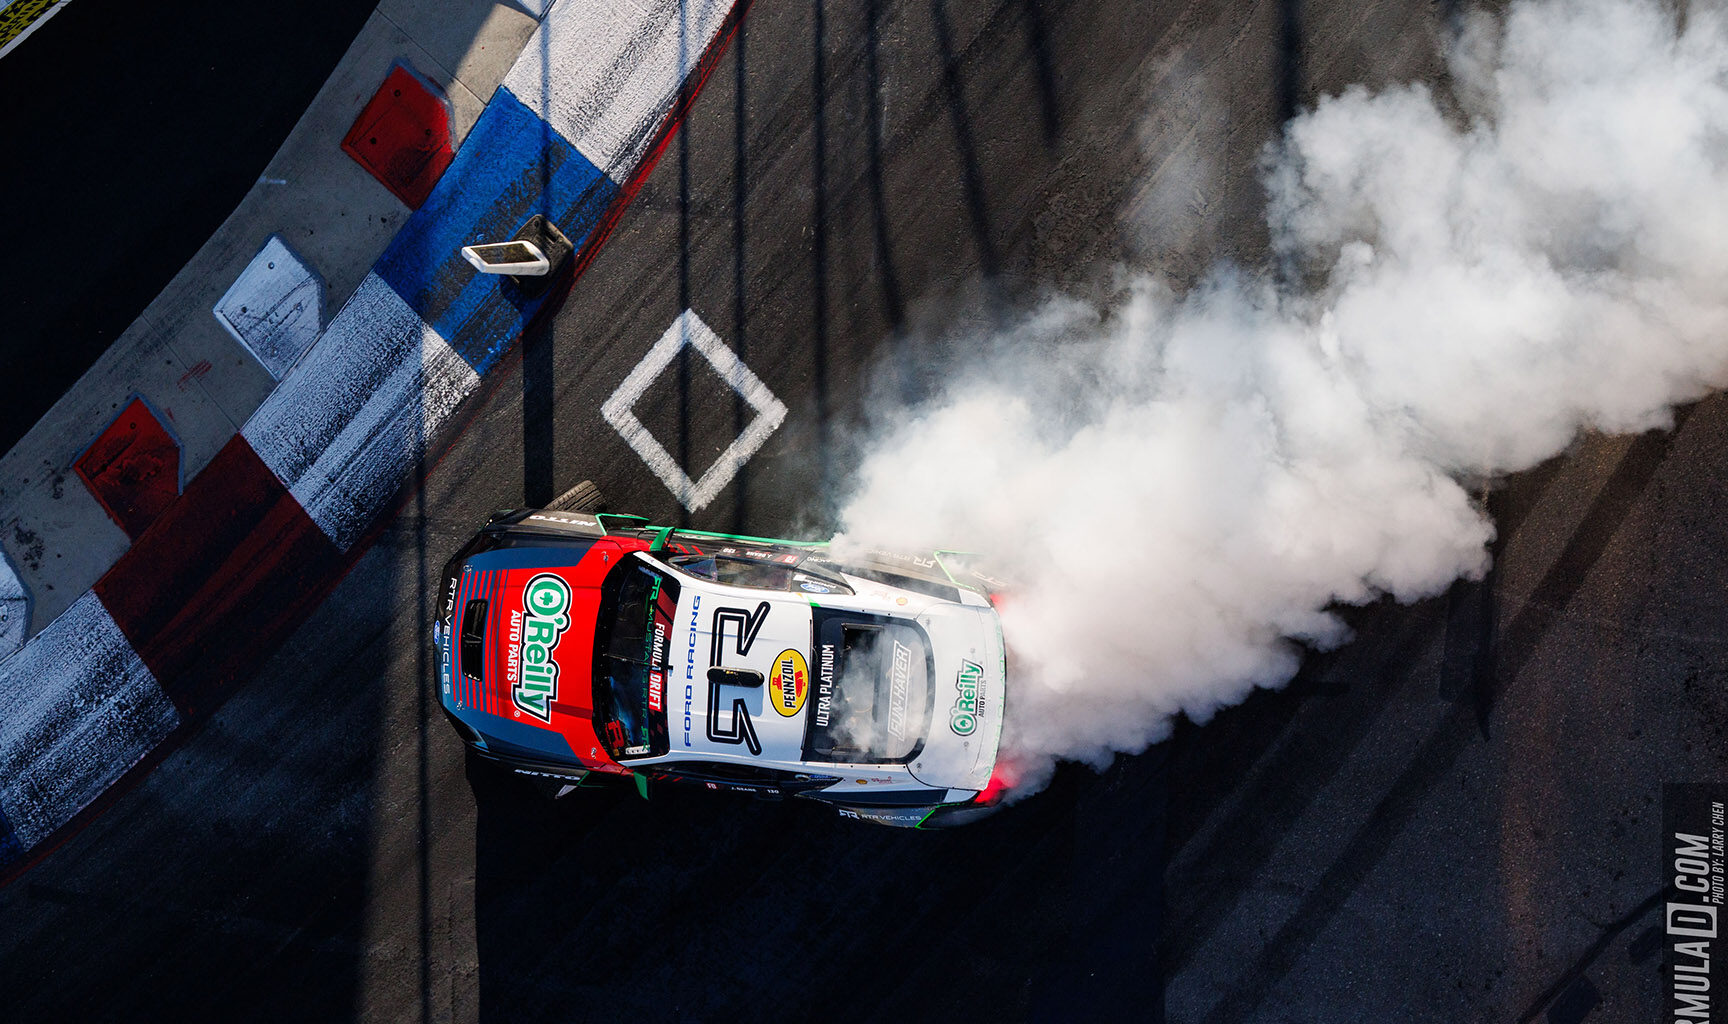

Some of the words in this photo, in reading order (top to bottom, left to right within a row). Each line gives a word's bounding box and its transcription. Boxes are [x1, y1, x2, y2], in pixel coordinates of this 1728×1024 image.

[529, 515, 597, 526] NITTO
[447, 577, 458, 611] RTR
[509, 609, 521, 642] AUTO
[518, 577, 568, 714] O'Reilly
[686, 595, 701, 680] RACING
[442, 614, 452, 695] VEHICLES
[507, 645, 519, 682] PARTS
[819, 644, 835, 695] PLATINUM
[649, 673, 661, 711] DRIFT
[781, 657, 797, 709] PENNZOIL
[890, 647, 908, 741] FUN-HAVER
[951, 661, 982, 735] O'Reilly
[684, 685, 693, 747] FORD
[816, 696, 831, 727] ULTRA
[978, 700, 986, 717] AUTO
[514, 768, 580, 780] NITTO
